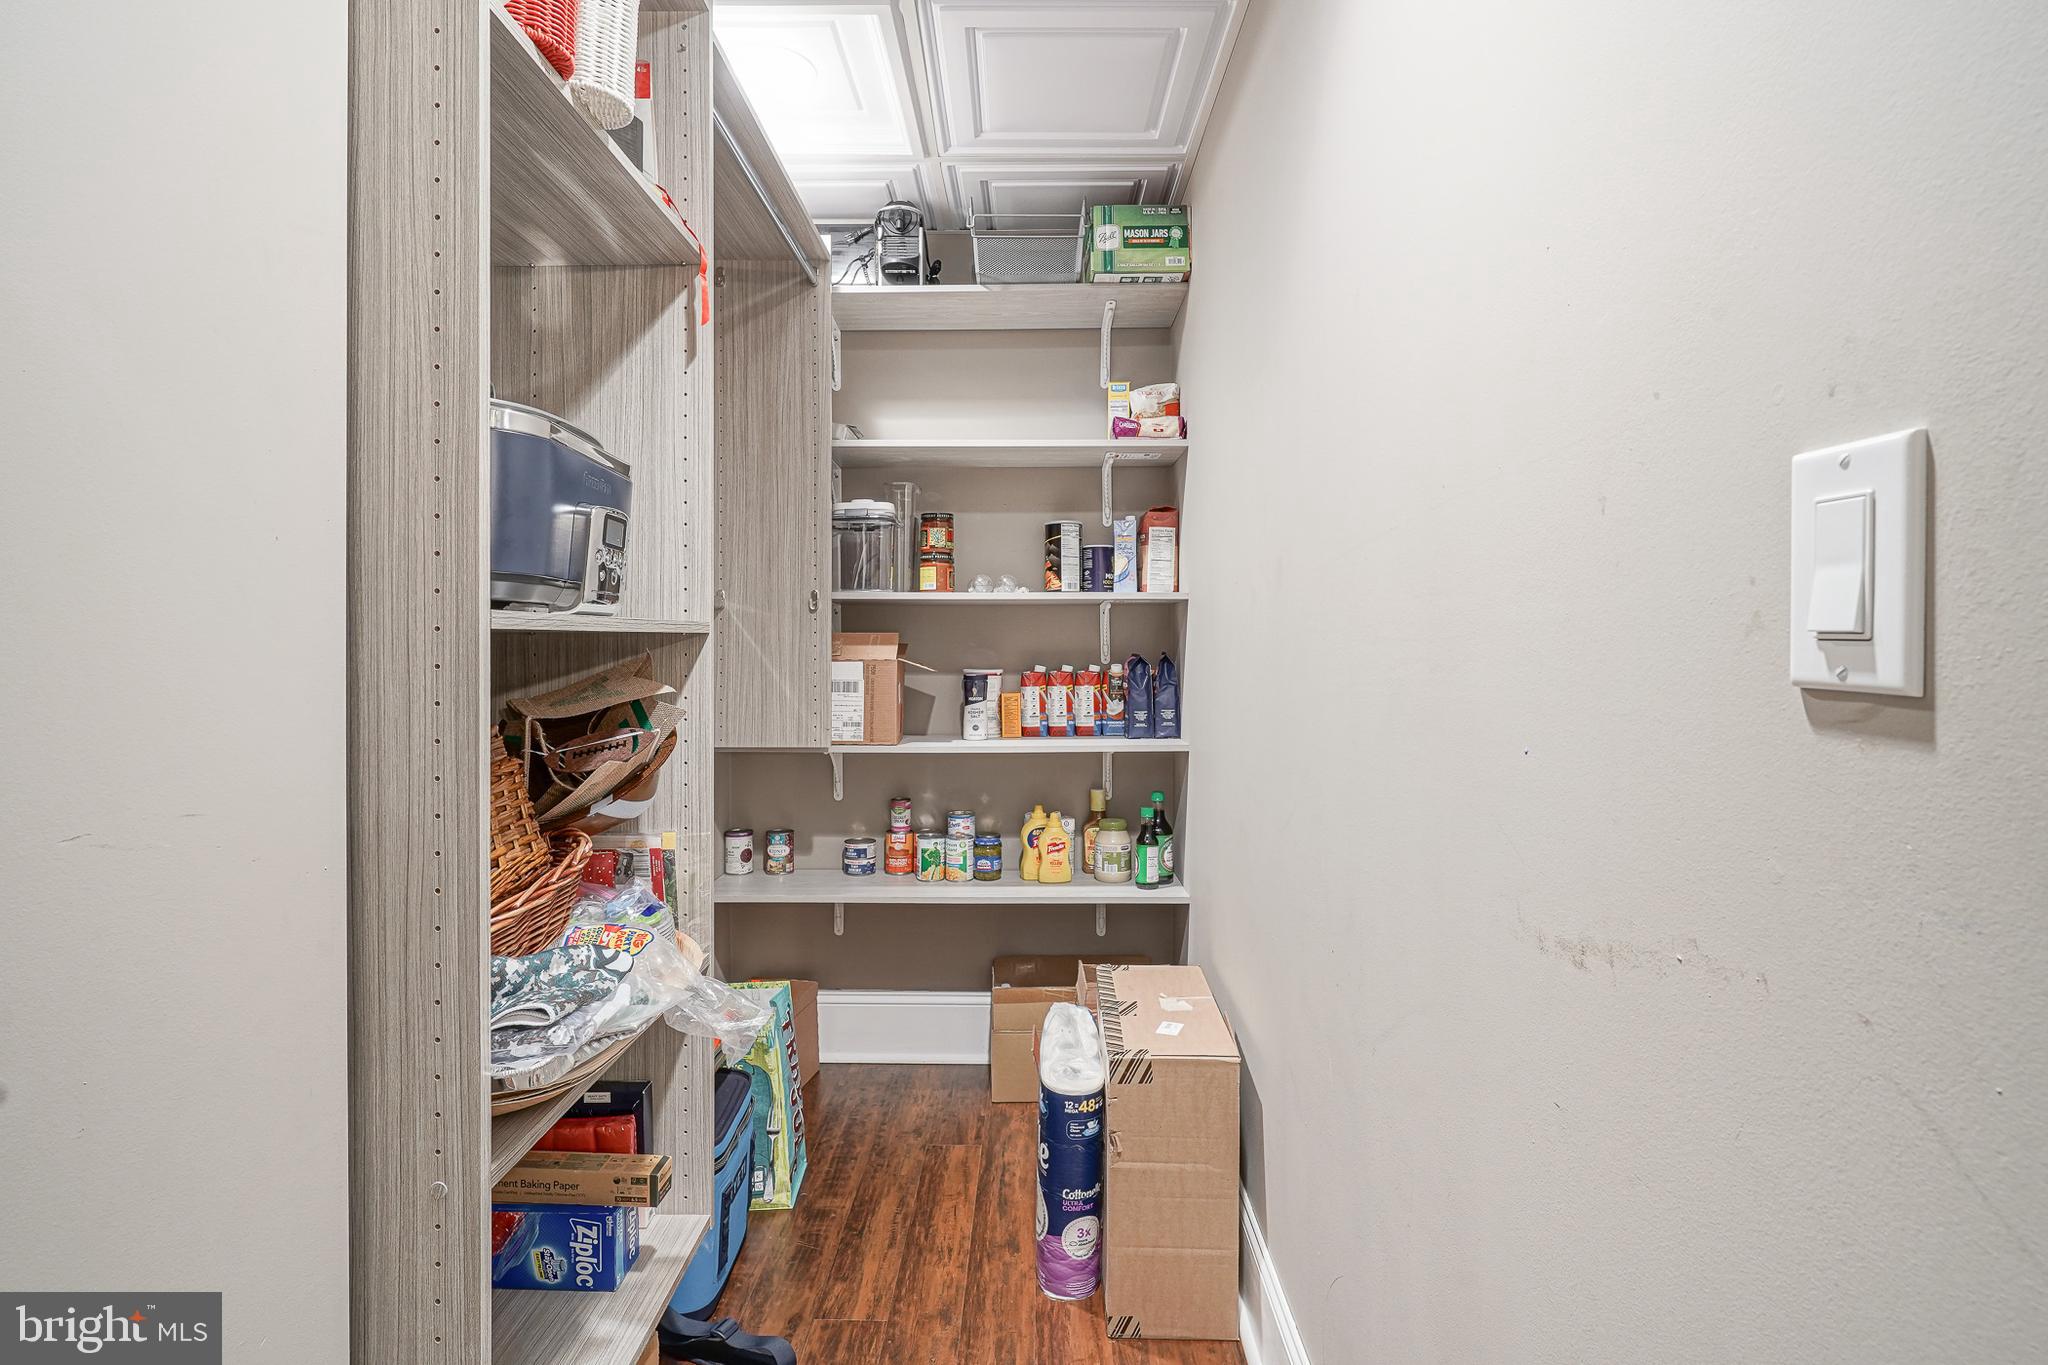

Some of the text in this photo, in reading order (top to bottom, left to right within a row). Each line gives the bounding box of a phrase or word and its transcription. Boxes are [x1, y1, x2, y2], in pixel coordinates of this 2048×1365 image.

[1123, 228, 1169, 238] MASON JARS
[614, 930, 627, 949] PACK
[621, 930, 637, 954] PARTY
[632, 932, 649, 949] BIG
[1064, 1101, 1074, 1109] 12
[1078, 1098, 1096, 1113] 48
[520, 1179, 551, 1192] Baking
[553, 1180, 580, 1192] Paper
[1062, 1202, 1094, 1212] COMFORT
[570, 1225, 598, 1287] Ziploc
